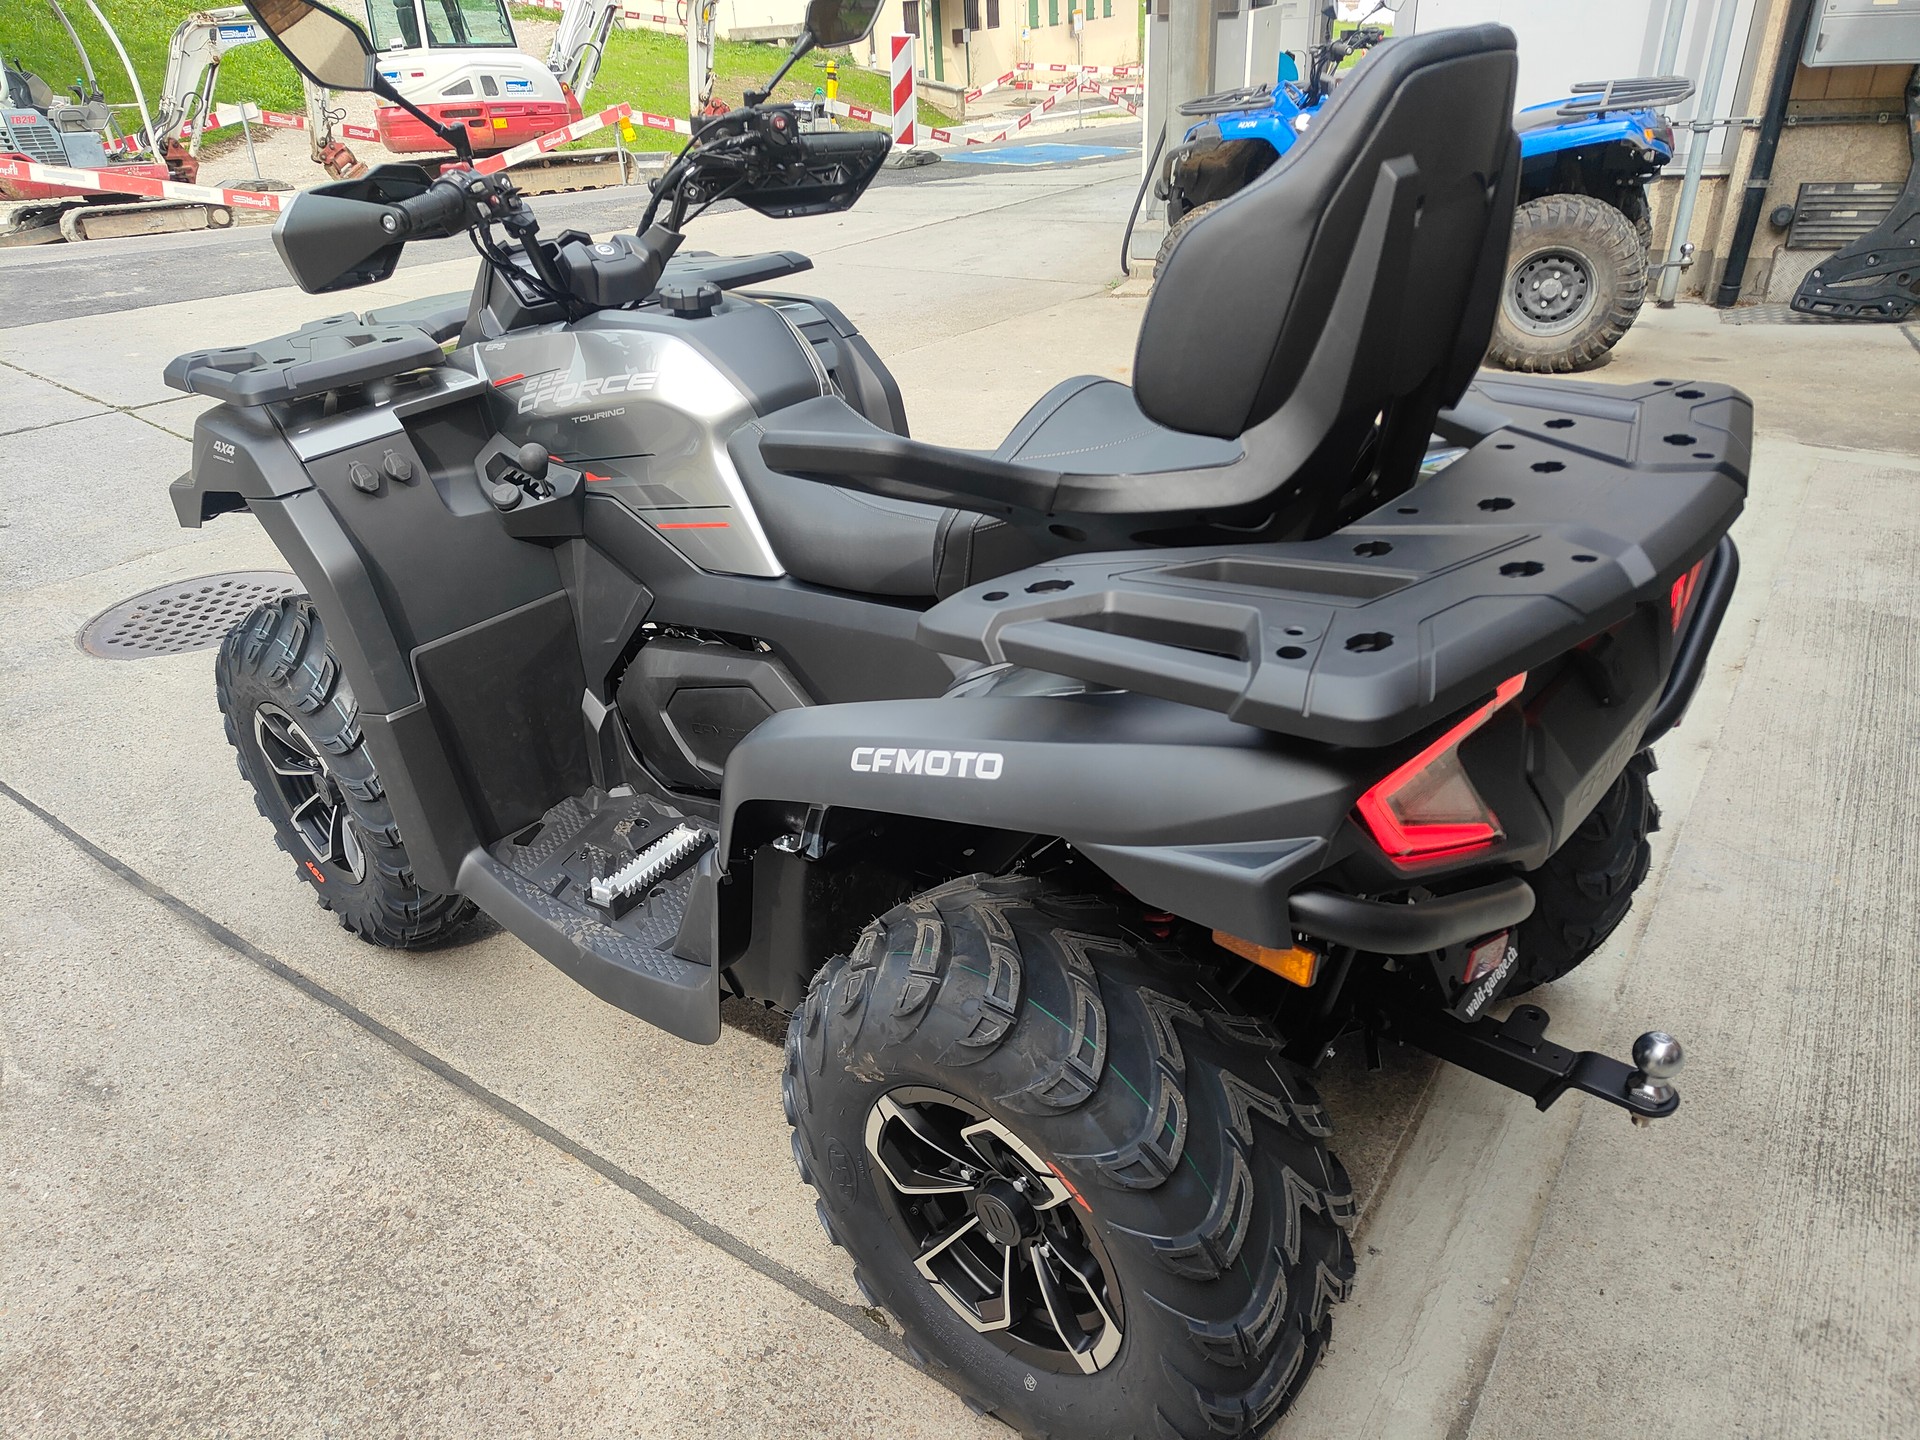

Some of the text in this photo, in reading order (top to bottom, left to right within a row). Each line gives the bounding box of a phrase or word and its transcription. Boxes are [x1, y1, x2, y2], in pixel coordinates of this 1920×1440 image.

[10, 115, 37, 125] TB219
[485, 342, 507, 351] EPS
[524, 369, 571, 393] 625
[517, 371, 660, 415] CFORCE
[571, 407, 626, 424] TOURING
[213, 440, 235, 457] 4X4
[850, 747, 1004, 780] CFMOTO
[305, 861, 325, 883] CST
[1465, 945, 1519, 1018] wald-garage.ch
